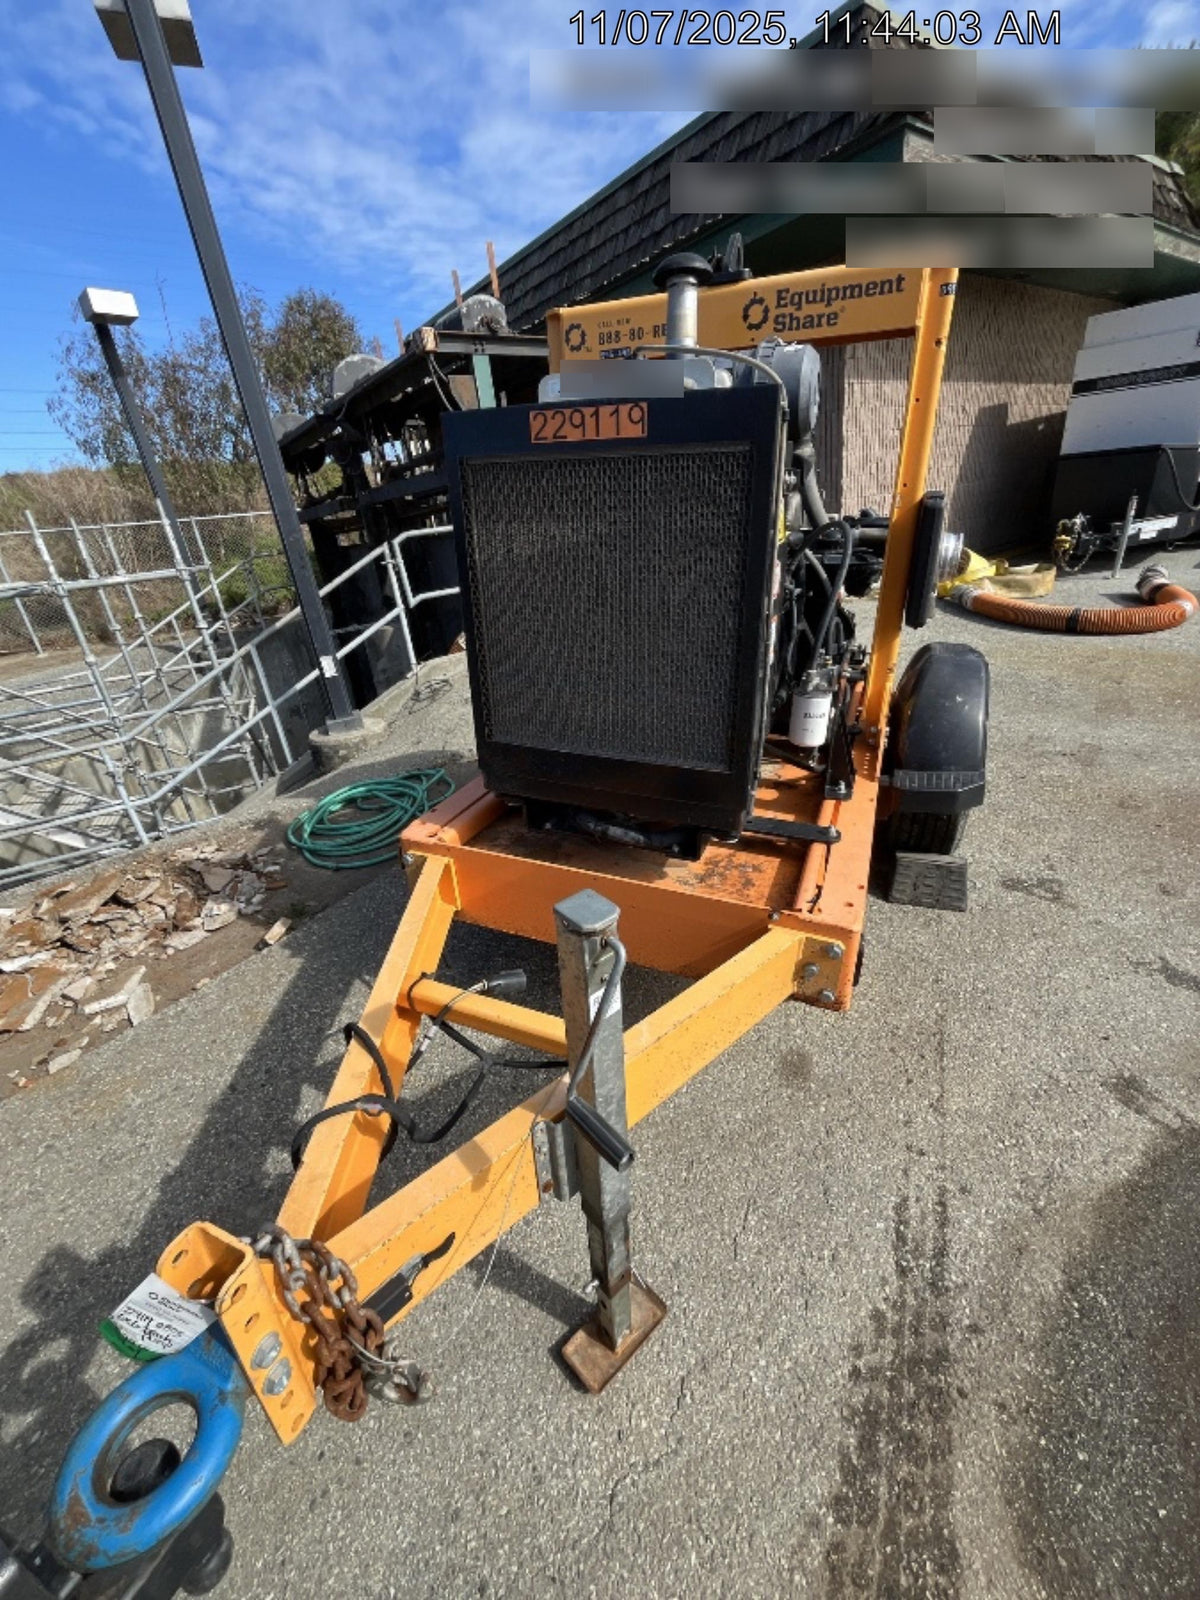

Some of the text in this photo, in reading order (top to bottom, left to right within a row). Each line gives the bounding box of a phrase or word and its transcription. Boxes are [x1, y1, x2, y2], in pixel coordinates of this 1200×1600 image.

[775, 273, 906, 312] Equipment
[598, 323, 668, 346] 888-80-RE
[773, 311, 839, 333] Share
[532, 404, 646, 442] 229119
